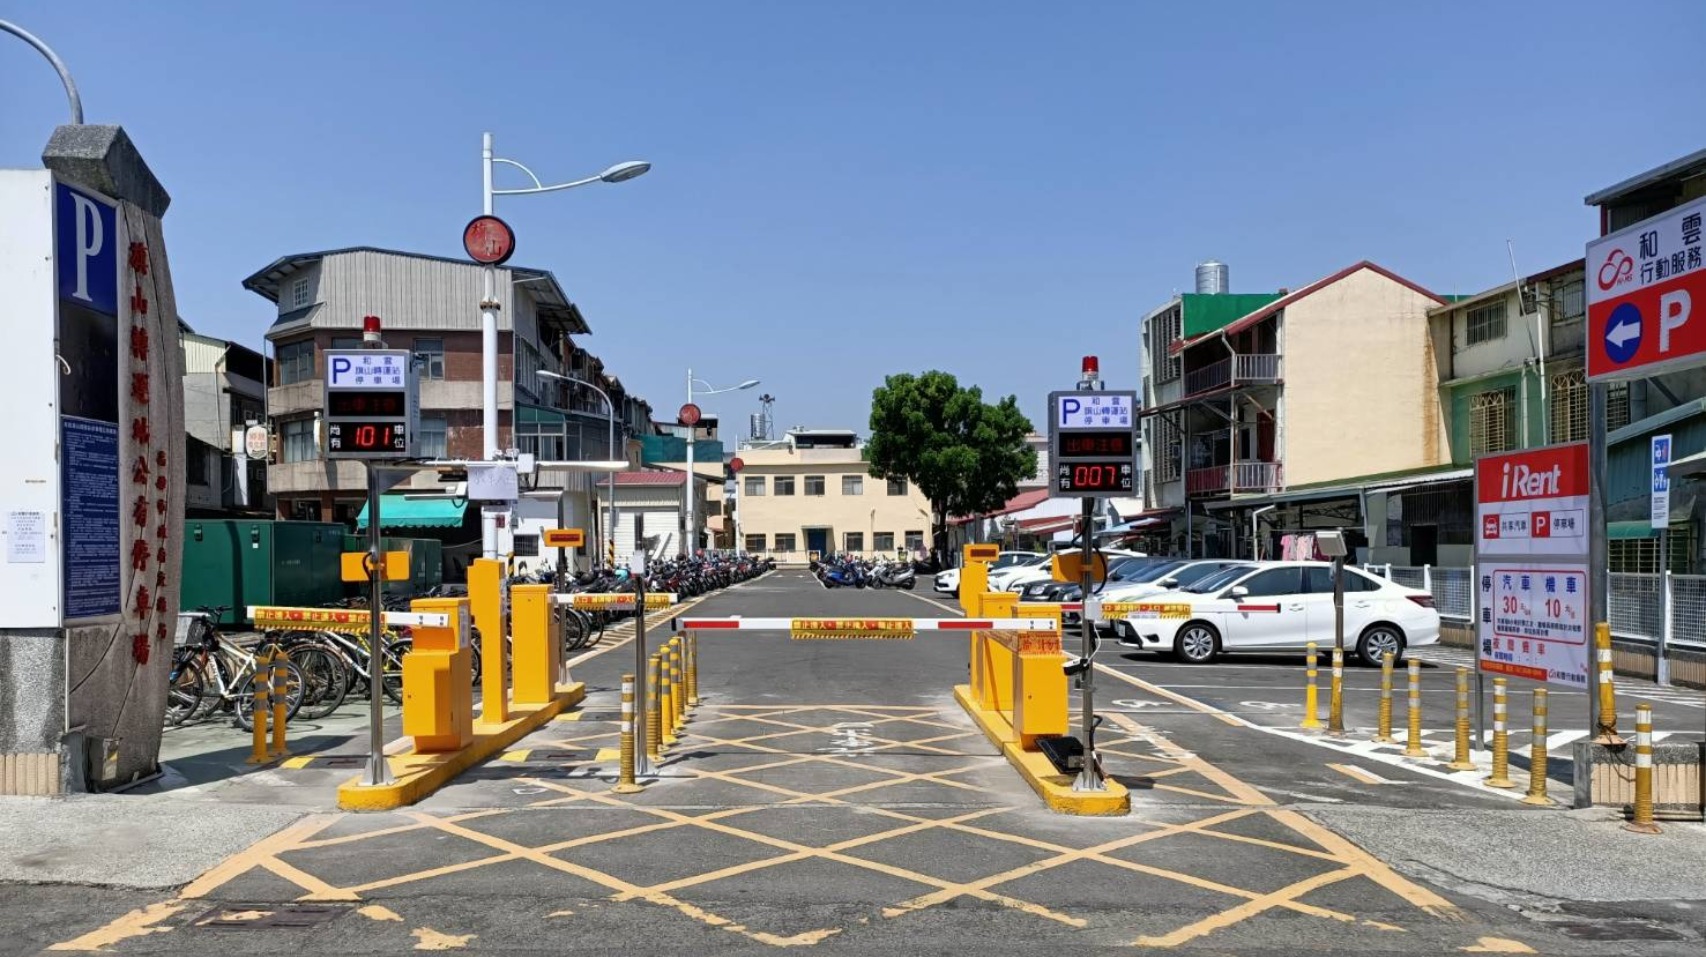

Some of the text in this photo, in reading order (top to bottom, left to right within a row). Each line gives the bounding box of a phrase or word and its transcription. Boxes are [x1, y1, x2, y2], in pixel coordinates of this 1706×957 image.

[69, 192, 104, 302] P
[1639, 212, 1702, 260] 和雲
[1640, 246, 1702, 285] 行動服務
[1660, 288, 1692, 354] P
[333, 358, 351, 384] P
[1063, 399, 1081, 424] P
[330, 424, 341, 449] 尚有
[356, 426, 390, 446] 101
[394, 424, 405, 448] 車位
[1060, 464, 1071, 489] 尚有
[1075, 466, 1116, 486] 007
[1121, 464, 1131, 489] 車位
[1502, 462, 1562, 498] iRent
[1536, 516, 1546, 534] P
[1503, 574, 1577, 594] 汽車 機車
[1482, 575, 1492, 656] 停車場
[1503, 595, 1518, 614] 30
[1545, 598, 1561, 618] 10
